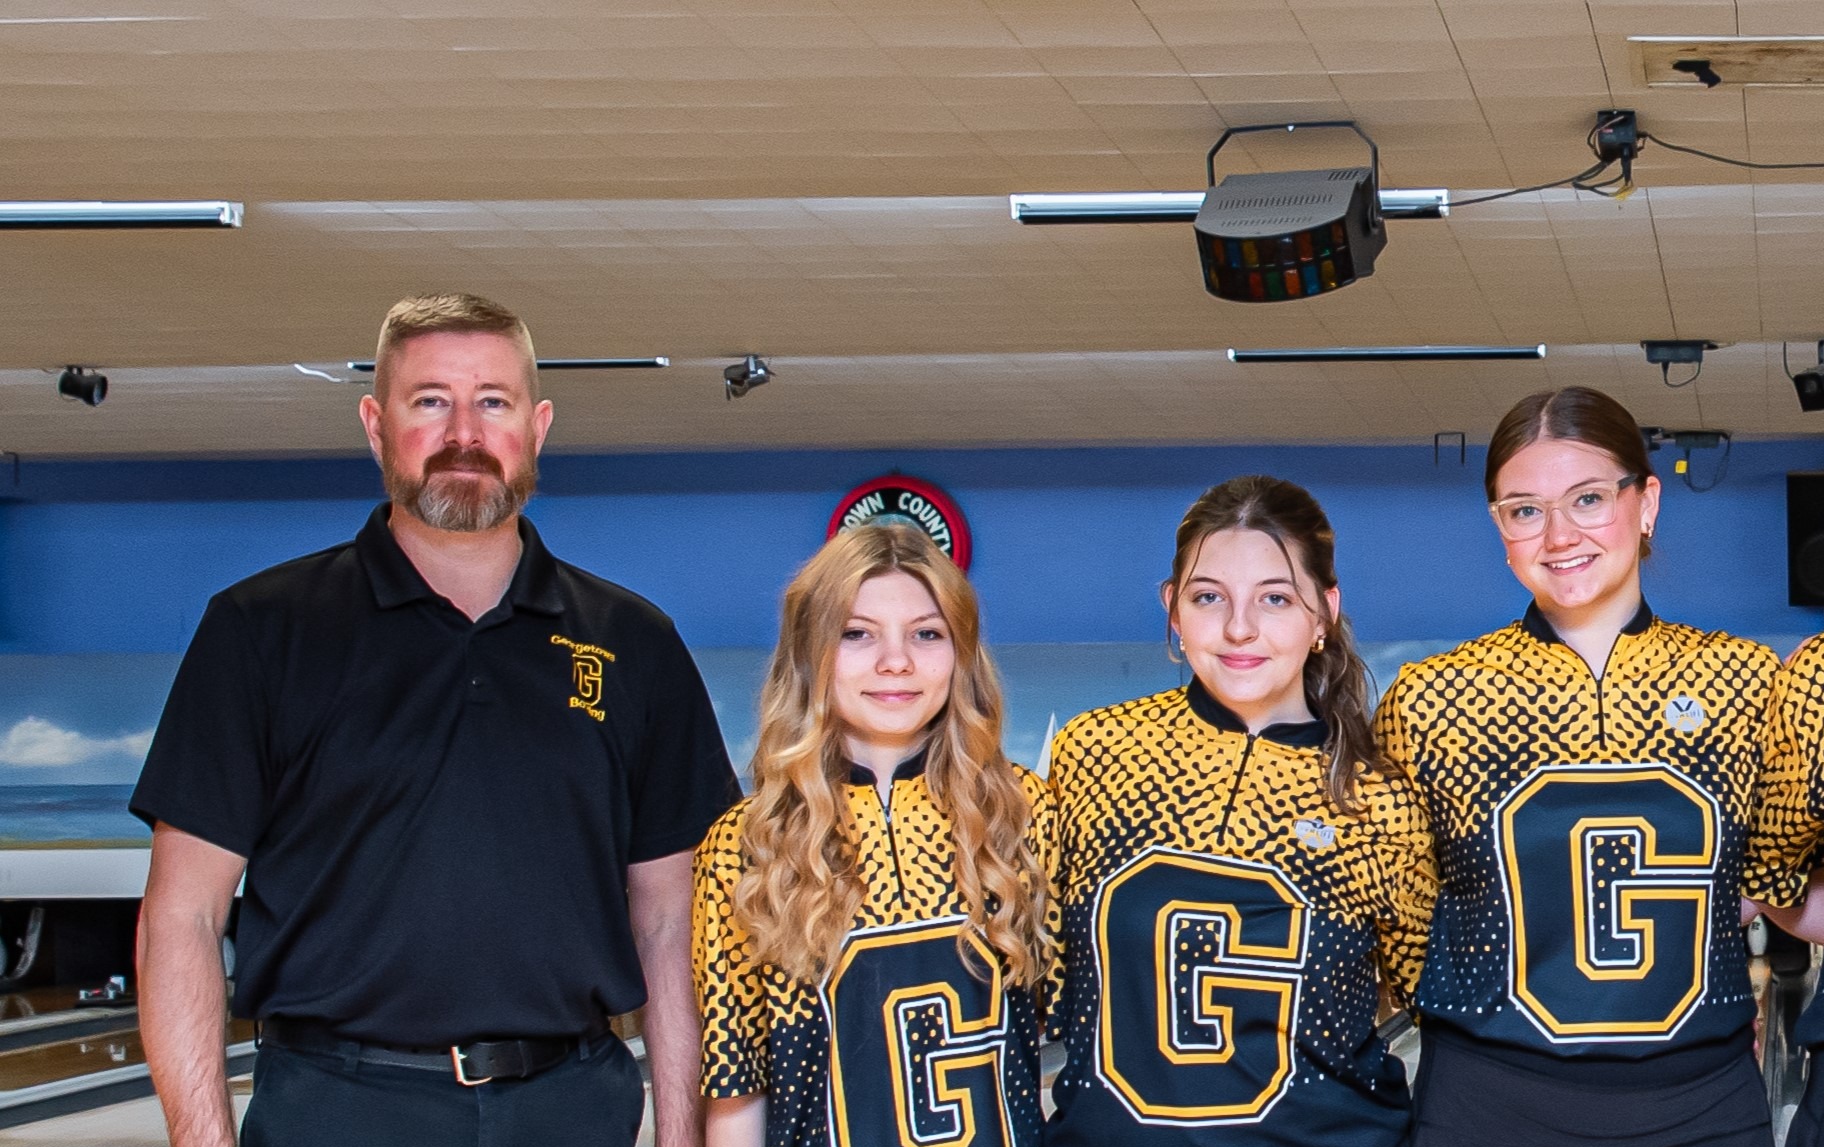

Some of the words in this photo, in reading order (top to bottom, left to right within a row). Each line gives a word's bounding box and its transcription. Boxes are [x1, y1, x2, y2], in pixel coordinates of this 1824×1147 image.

[572, 653, 602, 706] G
[1092, 845, 1315, 1127] G
[1495, 763, 1722, 1043] G
